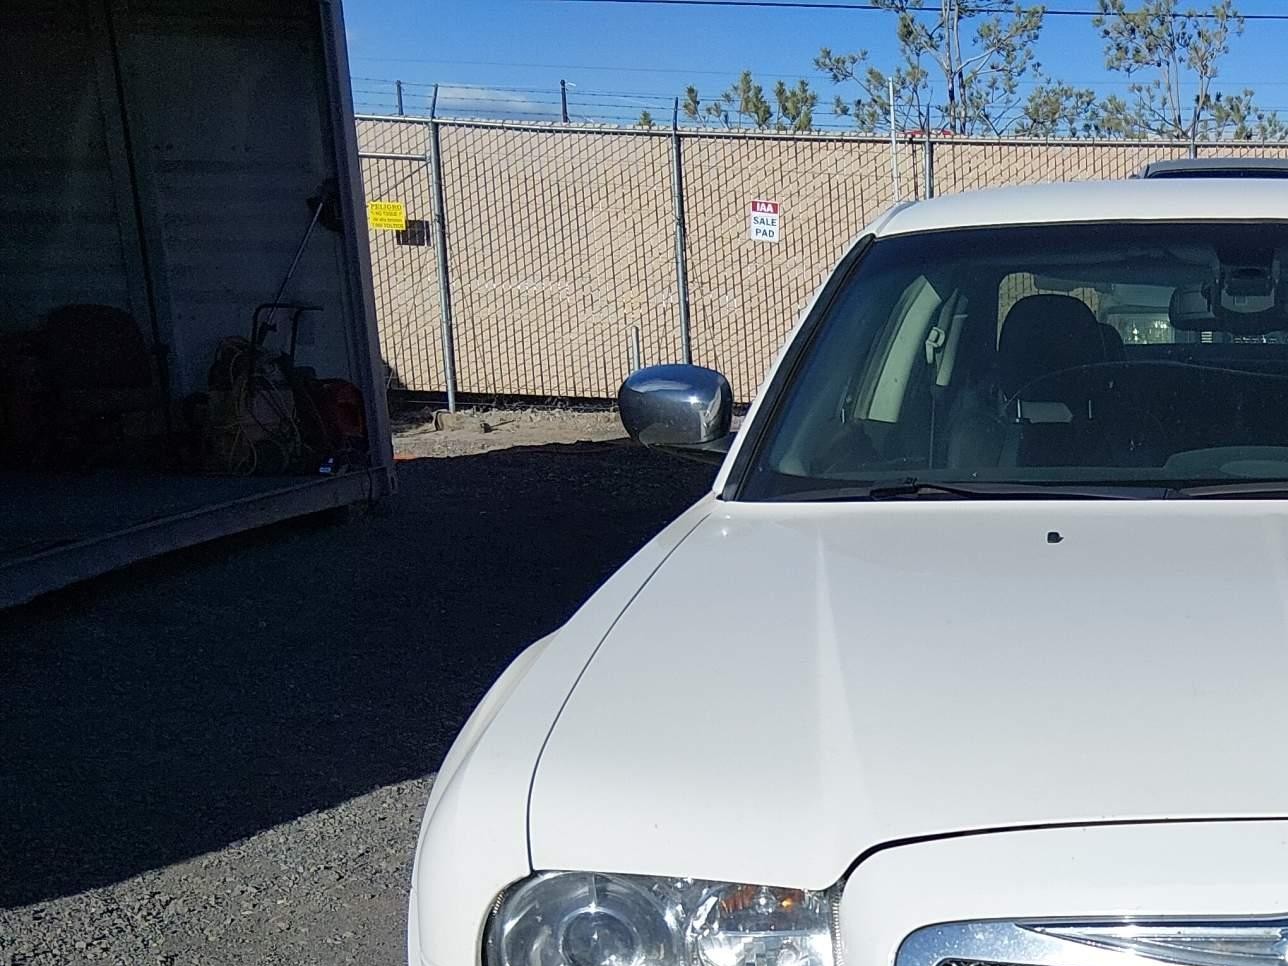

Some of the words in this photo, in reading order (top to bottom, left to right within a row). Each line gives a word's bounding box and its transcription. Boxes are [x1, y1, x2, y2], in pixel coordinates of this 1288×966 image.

[756, 202, 774, 213] IAA
[753, 216, 777, 227] SALE
[755, 228, 775, 238] PAD
